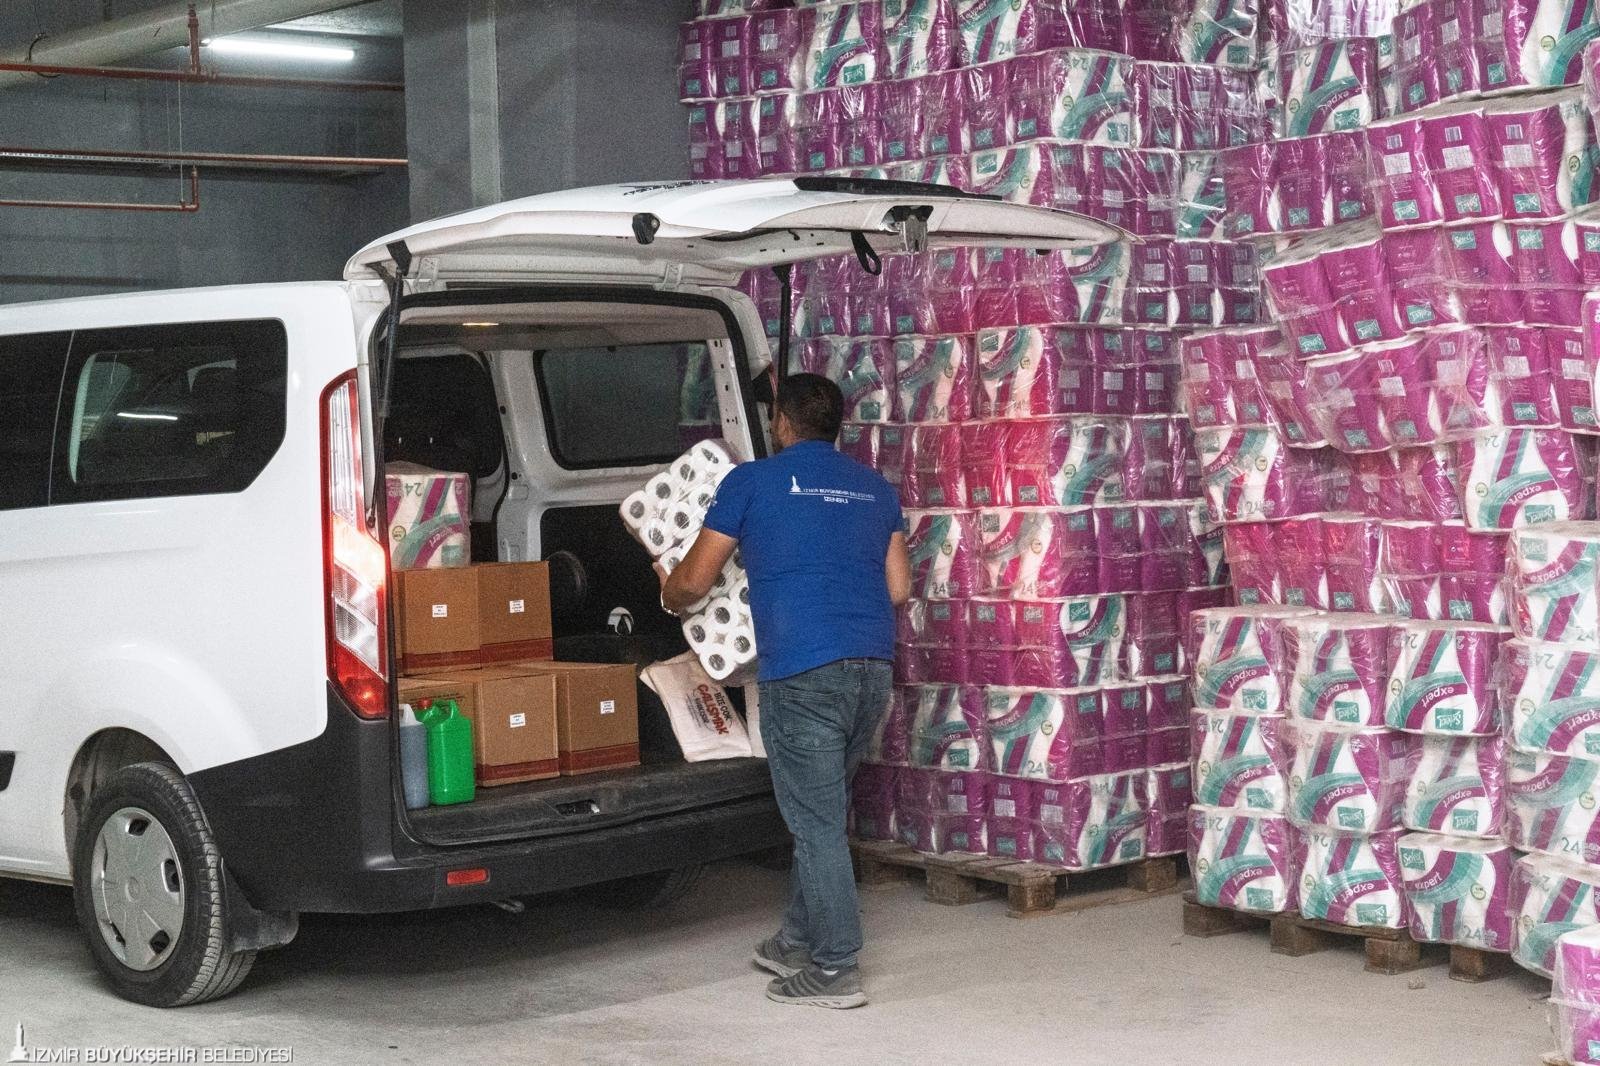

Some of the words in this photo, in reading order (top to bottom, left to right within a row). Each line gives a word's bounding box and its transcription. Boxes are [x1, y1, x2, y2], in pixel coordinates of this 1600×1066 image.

[1484, 435, 1498, 447] 24
[404, 482, 422, 497] 24
[1509, 485, 1541, 505] expert
[1530, 562, 1566, 583] expert
[932, 583, 947, 594] 24
[1534, 653, 1554, 669] 24
[1228, 669, 1257, 689] expert
[1324, 683, 1349, 700] expert
[1422, 686, 1454, 708] expert
[1211, 718, 1224, 733] 24
[1437, 711, 1462, 728] Select
[1028, 760, 1043, 773] 24
[1521, 776, 1552, 793] expert
[1323, 786, 1353, 805] expert
[1443, 790, 1472, 809] expert
[1209, 817, 1224, 831] 24
[1561, 836, 1580, 854] 24
[1232, 867, 1262, 887] expert
[1415, 872, 1443, 890] expert
[1463, 925, 1481, 940] 24
